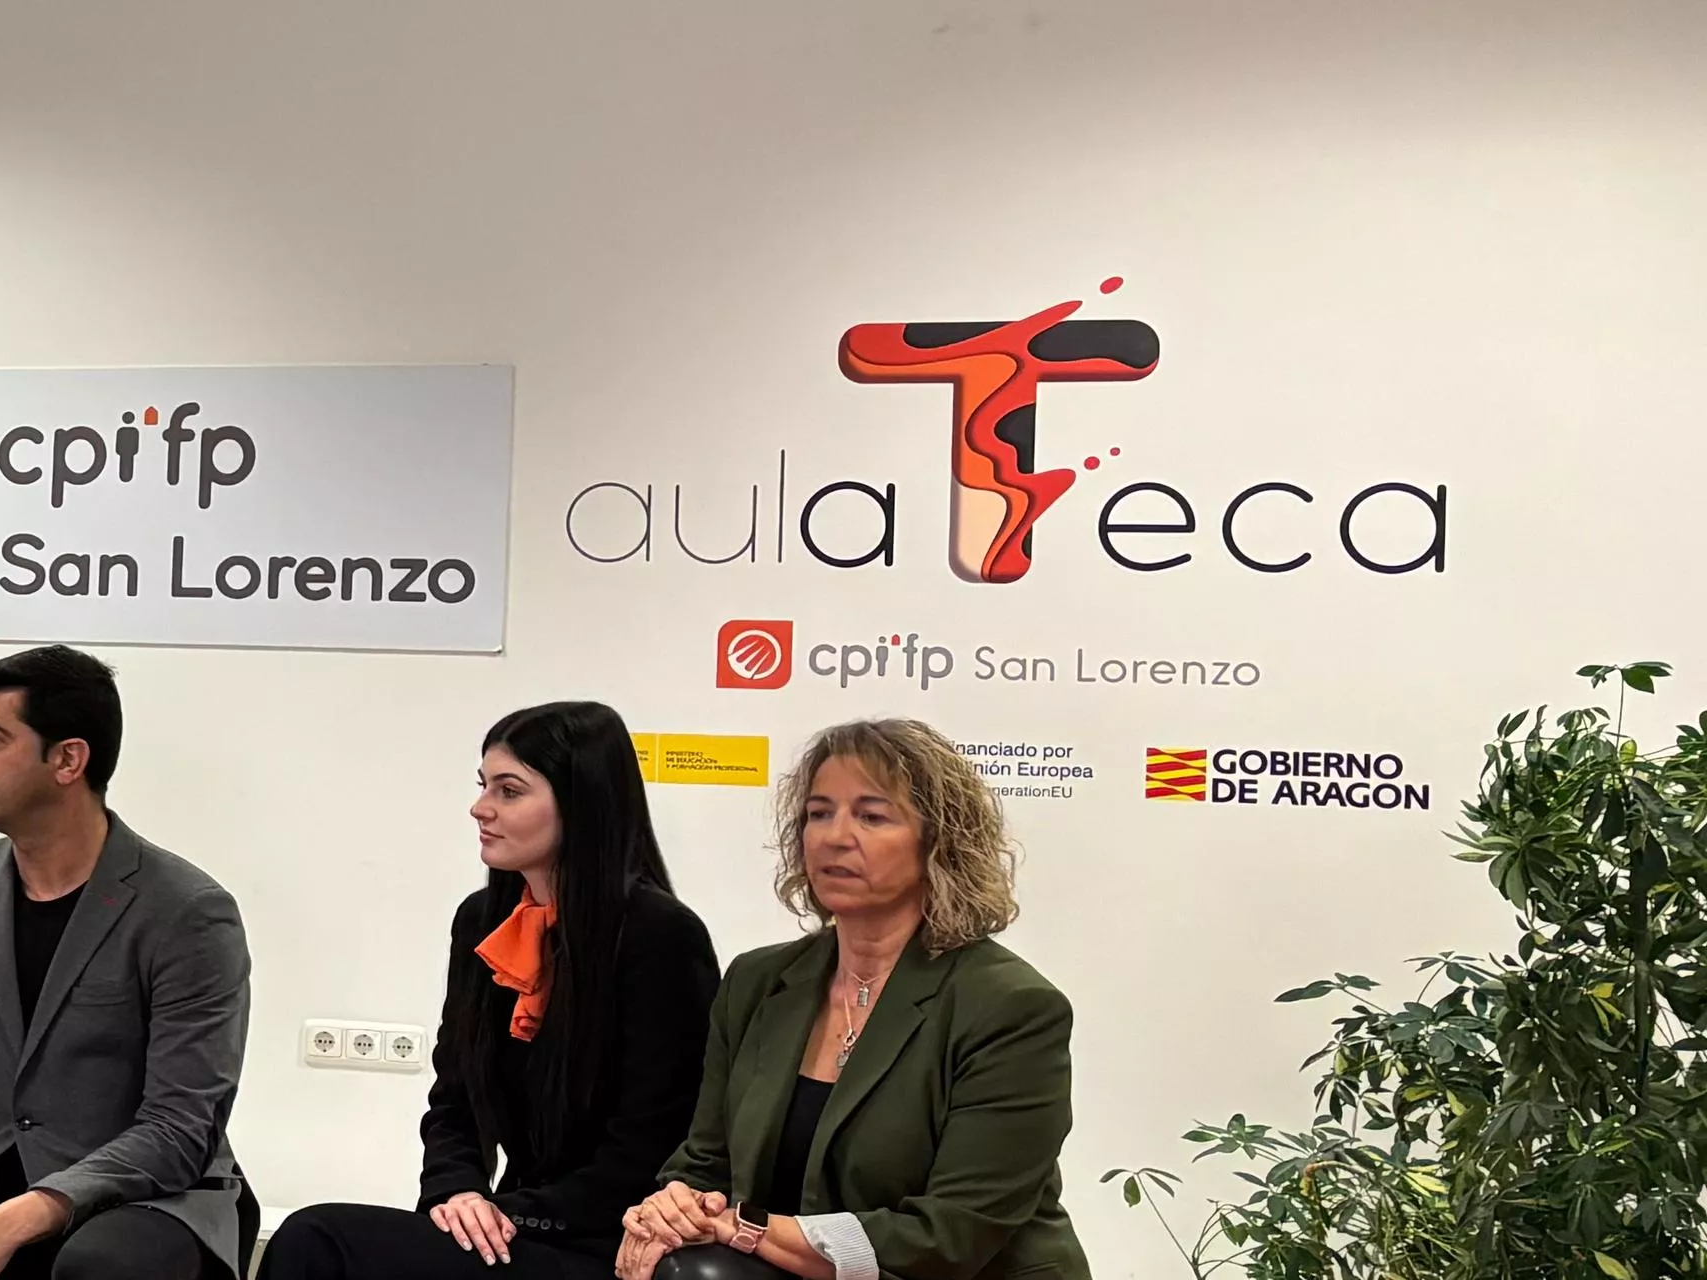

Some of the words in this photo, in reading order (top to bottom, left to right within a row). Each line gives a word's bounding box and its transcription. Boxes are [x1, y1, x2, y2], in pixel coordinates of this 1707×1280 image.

[170, 535, 476, 604] Lorenzo
[974, 645, 1056, 683] San
[1076, 647, 1262, 687] Lorenzo
[1043, 745, 1074, 761] por
[1212, 748, 1404, 780] GOBIERNO
[971, 760, 1011, 776] nión
[1017, 761, 1094, 781] Europea
[1211, 777, 1259, 804] DE
[1271, 780, 1430, 810] ARAGON
